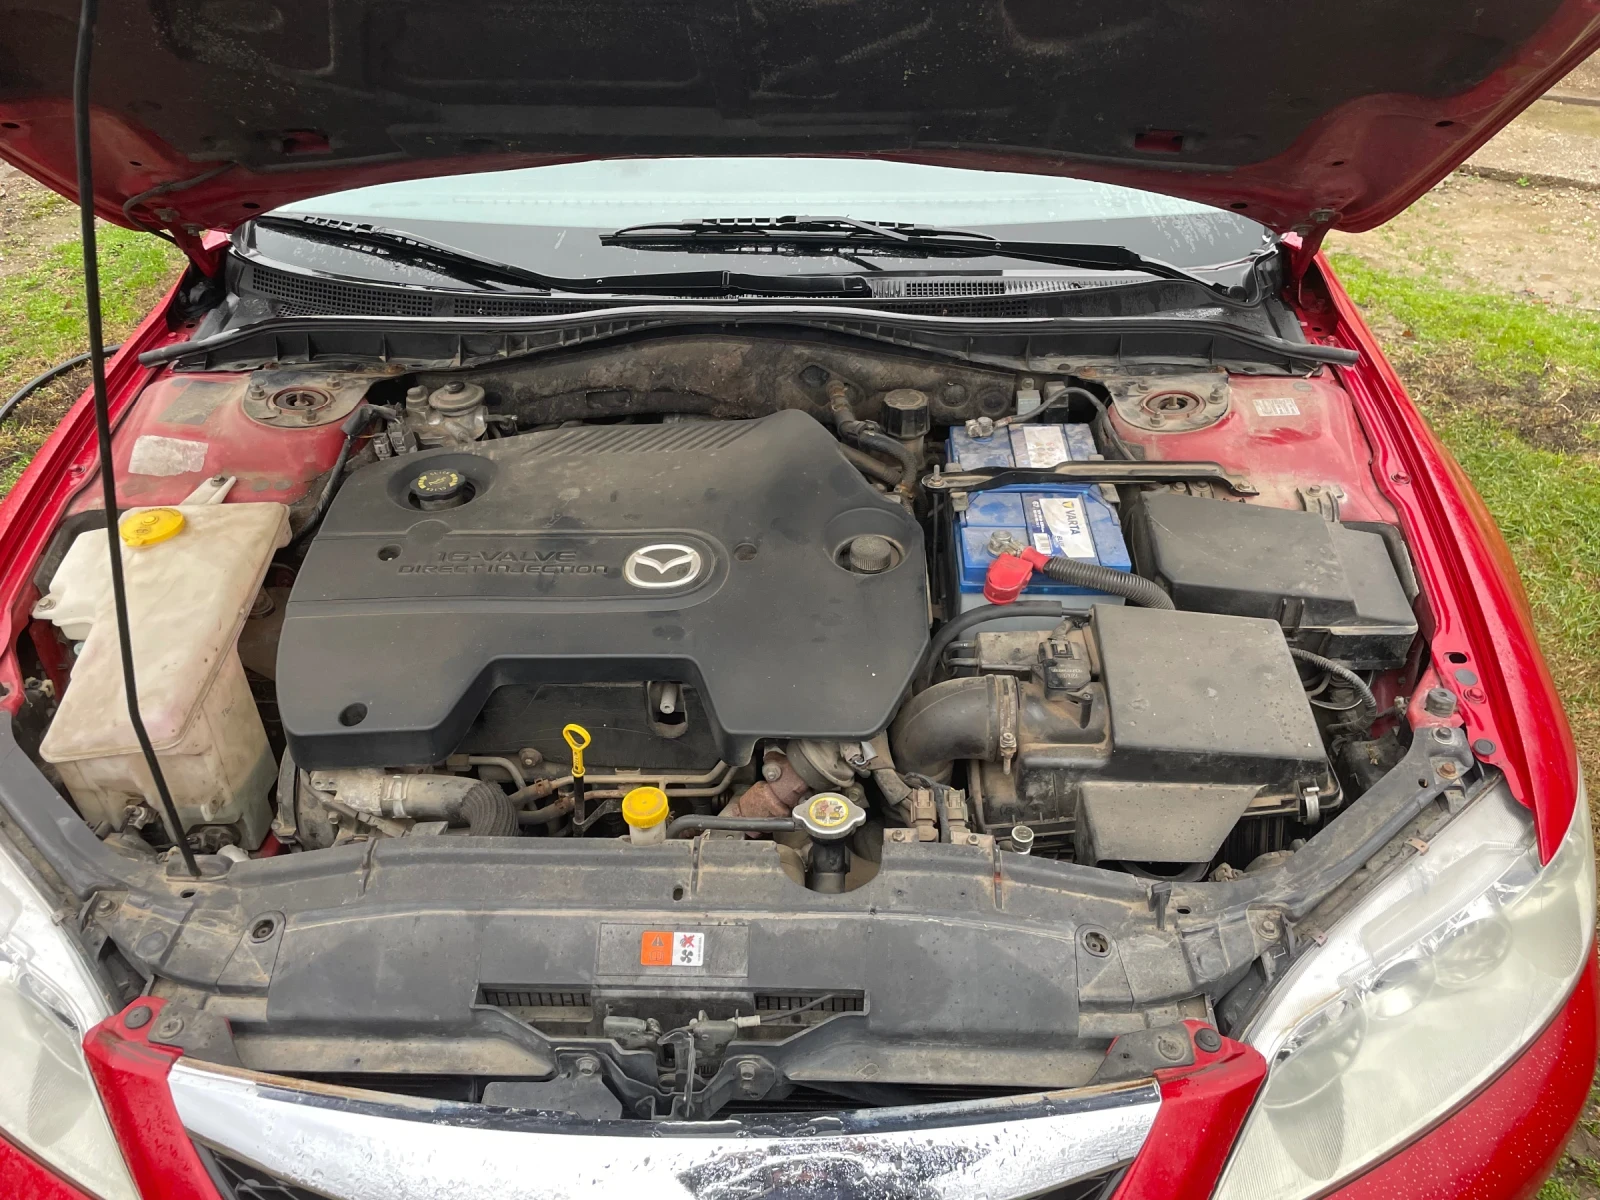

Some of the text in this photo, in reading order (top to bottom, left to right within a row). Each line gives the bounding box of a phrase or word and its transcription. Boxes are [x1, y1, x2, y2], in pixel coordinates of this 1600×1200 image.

[1065, 509, 1081, 535] VARTA
[437, 550, 577, 563] 16-VALVE
[398, 563, 484, 575] DIRECT
